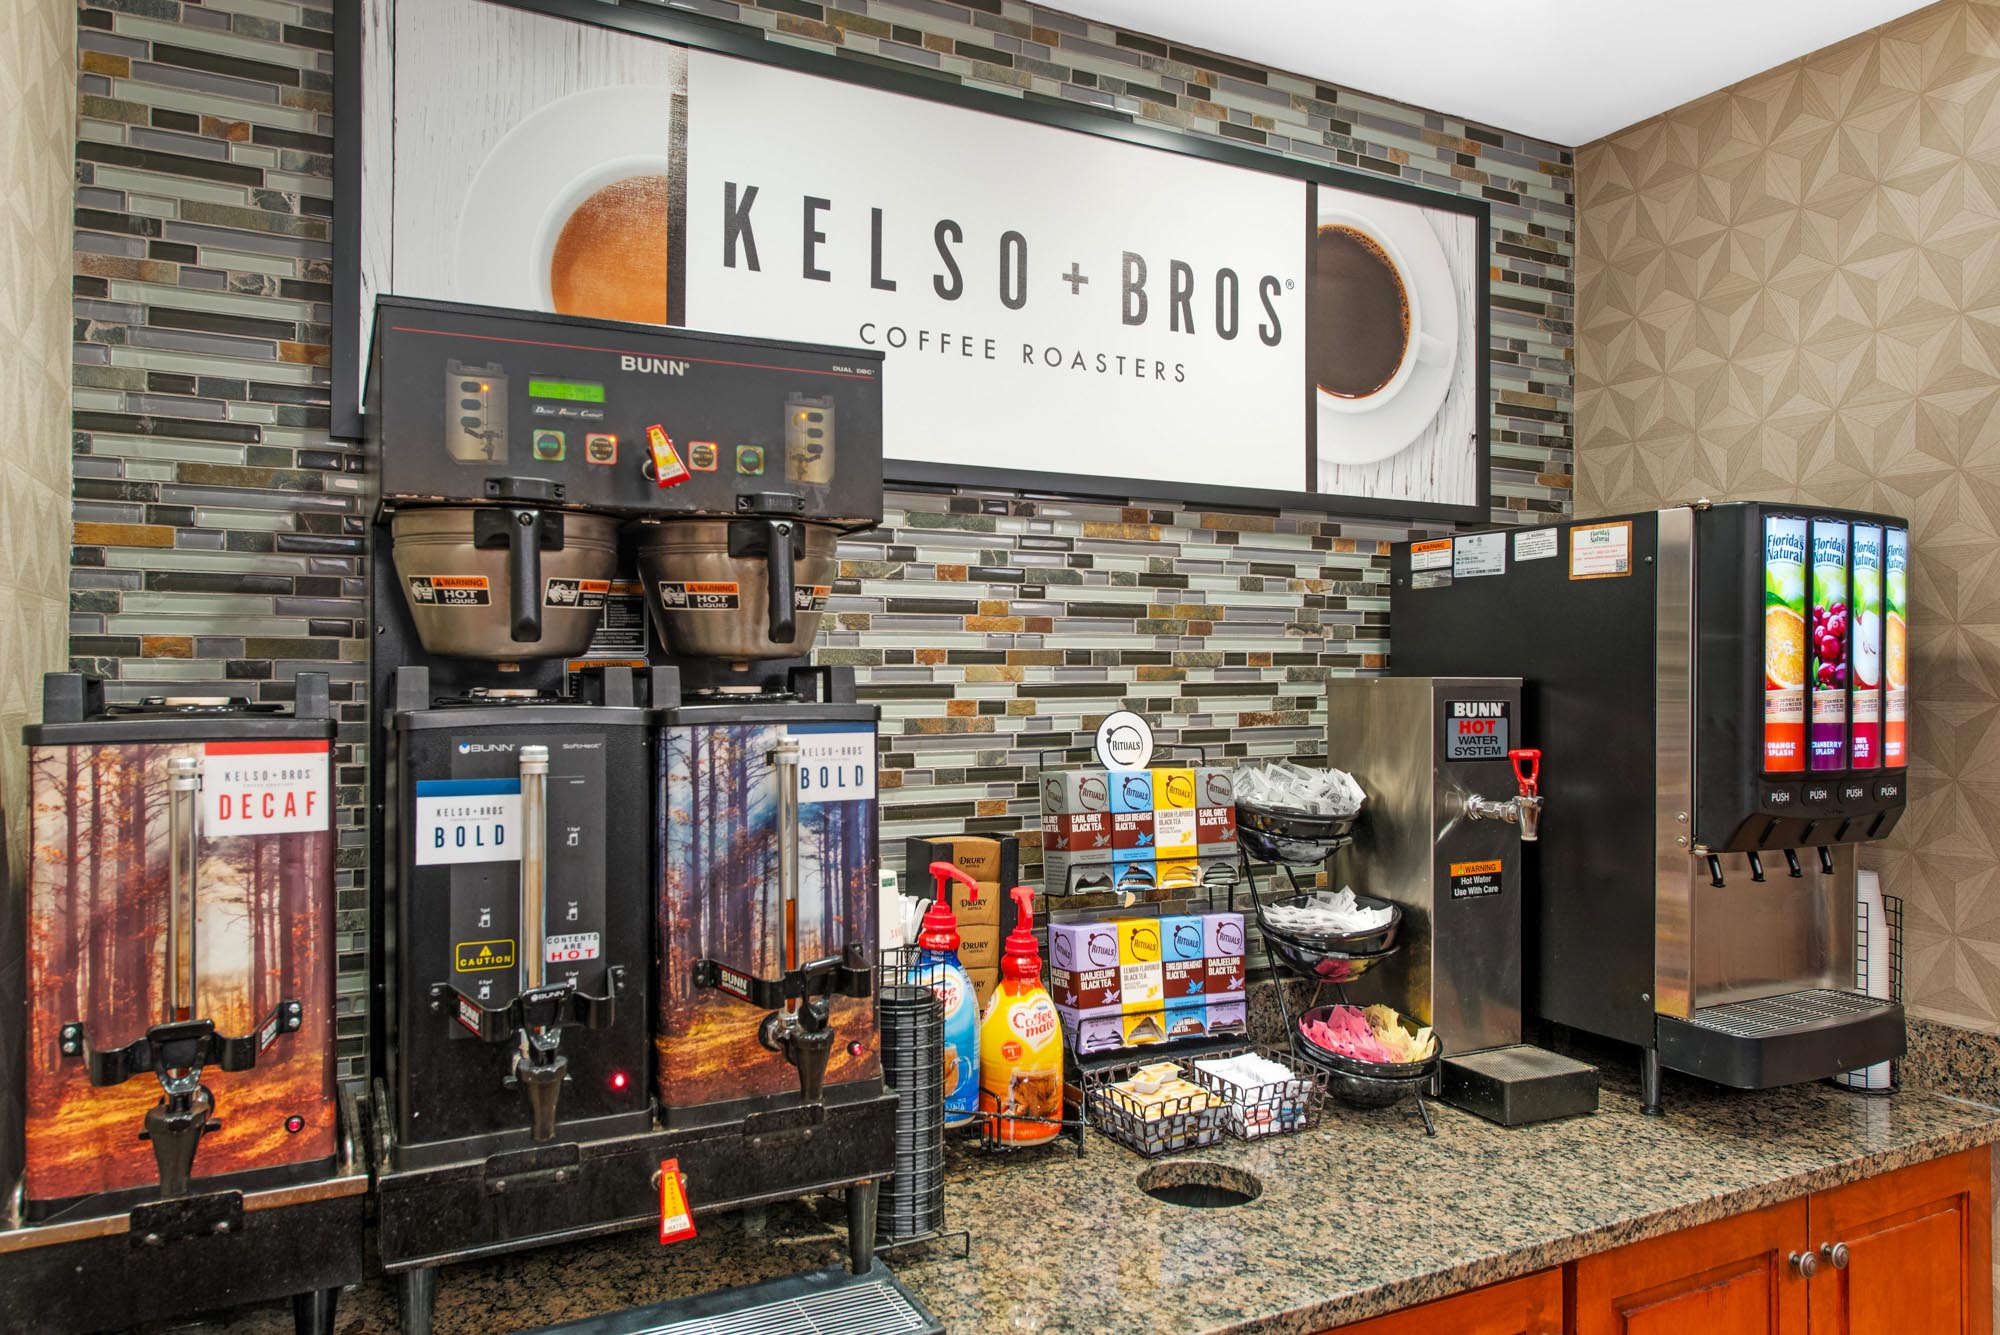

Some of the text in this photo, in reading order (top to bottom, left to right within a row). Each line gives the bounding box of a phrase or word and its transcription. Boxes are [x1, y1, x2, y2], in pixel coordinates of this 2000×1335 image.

[723, 181, 1028, 310] KELSO
[859, 323, 1185, 383] COFFEE ROASTERS
[832, 365, 853, 373] DUAL
[1767, 533, 1804, 550] Florida's
[1767, 548, 1802, 563] Natural
[1814, 550, 1844, 566] Natural
[444, 579, 483, 587] WARNING
[444, 590, 477, 599] HOT
[696, 595, 728, 603] HOT
[1459, 720, 1496, 734] HOT
[1458, 736, 1498, 745] WATER
[1454, 747, 1501, 756] SYSTEM
[224, 771, 268, 782] KELSO
[801, 765, 863, 789] BOLD
[1082, 788, 1104, 800] RITUALS
[1126, 787, 1149, 801] RITUALS
[1169, 785, 1190, 798] RITUALS
[1209, 784, 1231, 797] RITUALS
[1809, 790, 1827, 800] PUSH
[1846, 788, 1863, 798] PUSH
[1881, 787, 1897, 796] PUSH
[1771, 793, 1789, 802] PUSH
[219, 790, 316, 820] DECAF
[436, 808, 470, 817] KELSO
[1115, 812, 1152, 822] ENGLISH BREAKFAST
[1214, 808, 1227, 816] GREY
[1072, 814, 1101, 823] EARL GREY
[1200, 817, 1218, 826] BLACK
[1072, 823, 1091, 832] BLACK
[1115, 822, 1127, 830] BLACK
[434, 824, 505, 848] BOLD
[960, 856, 986, 864] DRURY
[1465, 864, 1496, 873] WARNING
[1473, 875, 1492, 883] Water
[1454, 886, 1499, 896] Use With Care
[547, 934, 598, 944] CONTENTS
[1177, 935, 1199, 949] RITUALS
[1219, 933, 1241, 945] RITUALS
[564, 942, 582, 950] ARE
[961, 941, 988, 950] DRURY
[1091, 945, 1115, 956] RITUALS
[1134, 939, 1156, 952] RITUALS
[551, 949, 594, 961] HOT
[460, 955, 511, 967] CAUTION
[1166, 960, 1202, 971] ENGLISH BREAKFAST
[1208, 957, 1240, 967] DARJEELING
[1124, 963, 1159, 974] LEMON FLAVORED
[1208, 967, 1227, 976] BLACK
[721, 970, 747, 989] BUNN
[1080, 969, 1115, 981] DARJEELING
[1166, 971, 1178, 980] BLACK
[1081, 980, 1101, 990] BLACK
[1012, 1010, 1052, 1029] Coffee
[1026, 1018, 1055, 1037] mate
